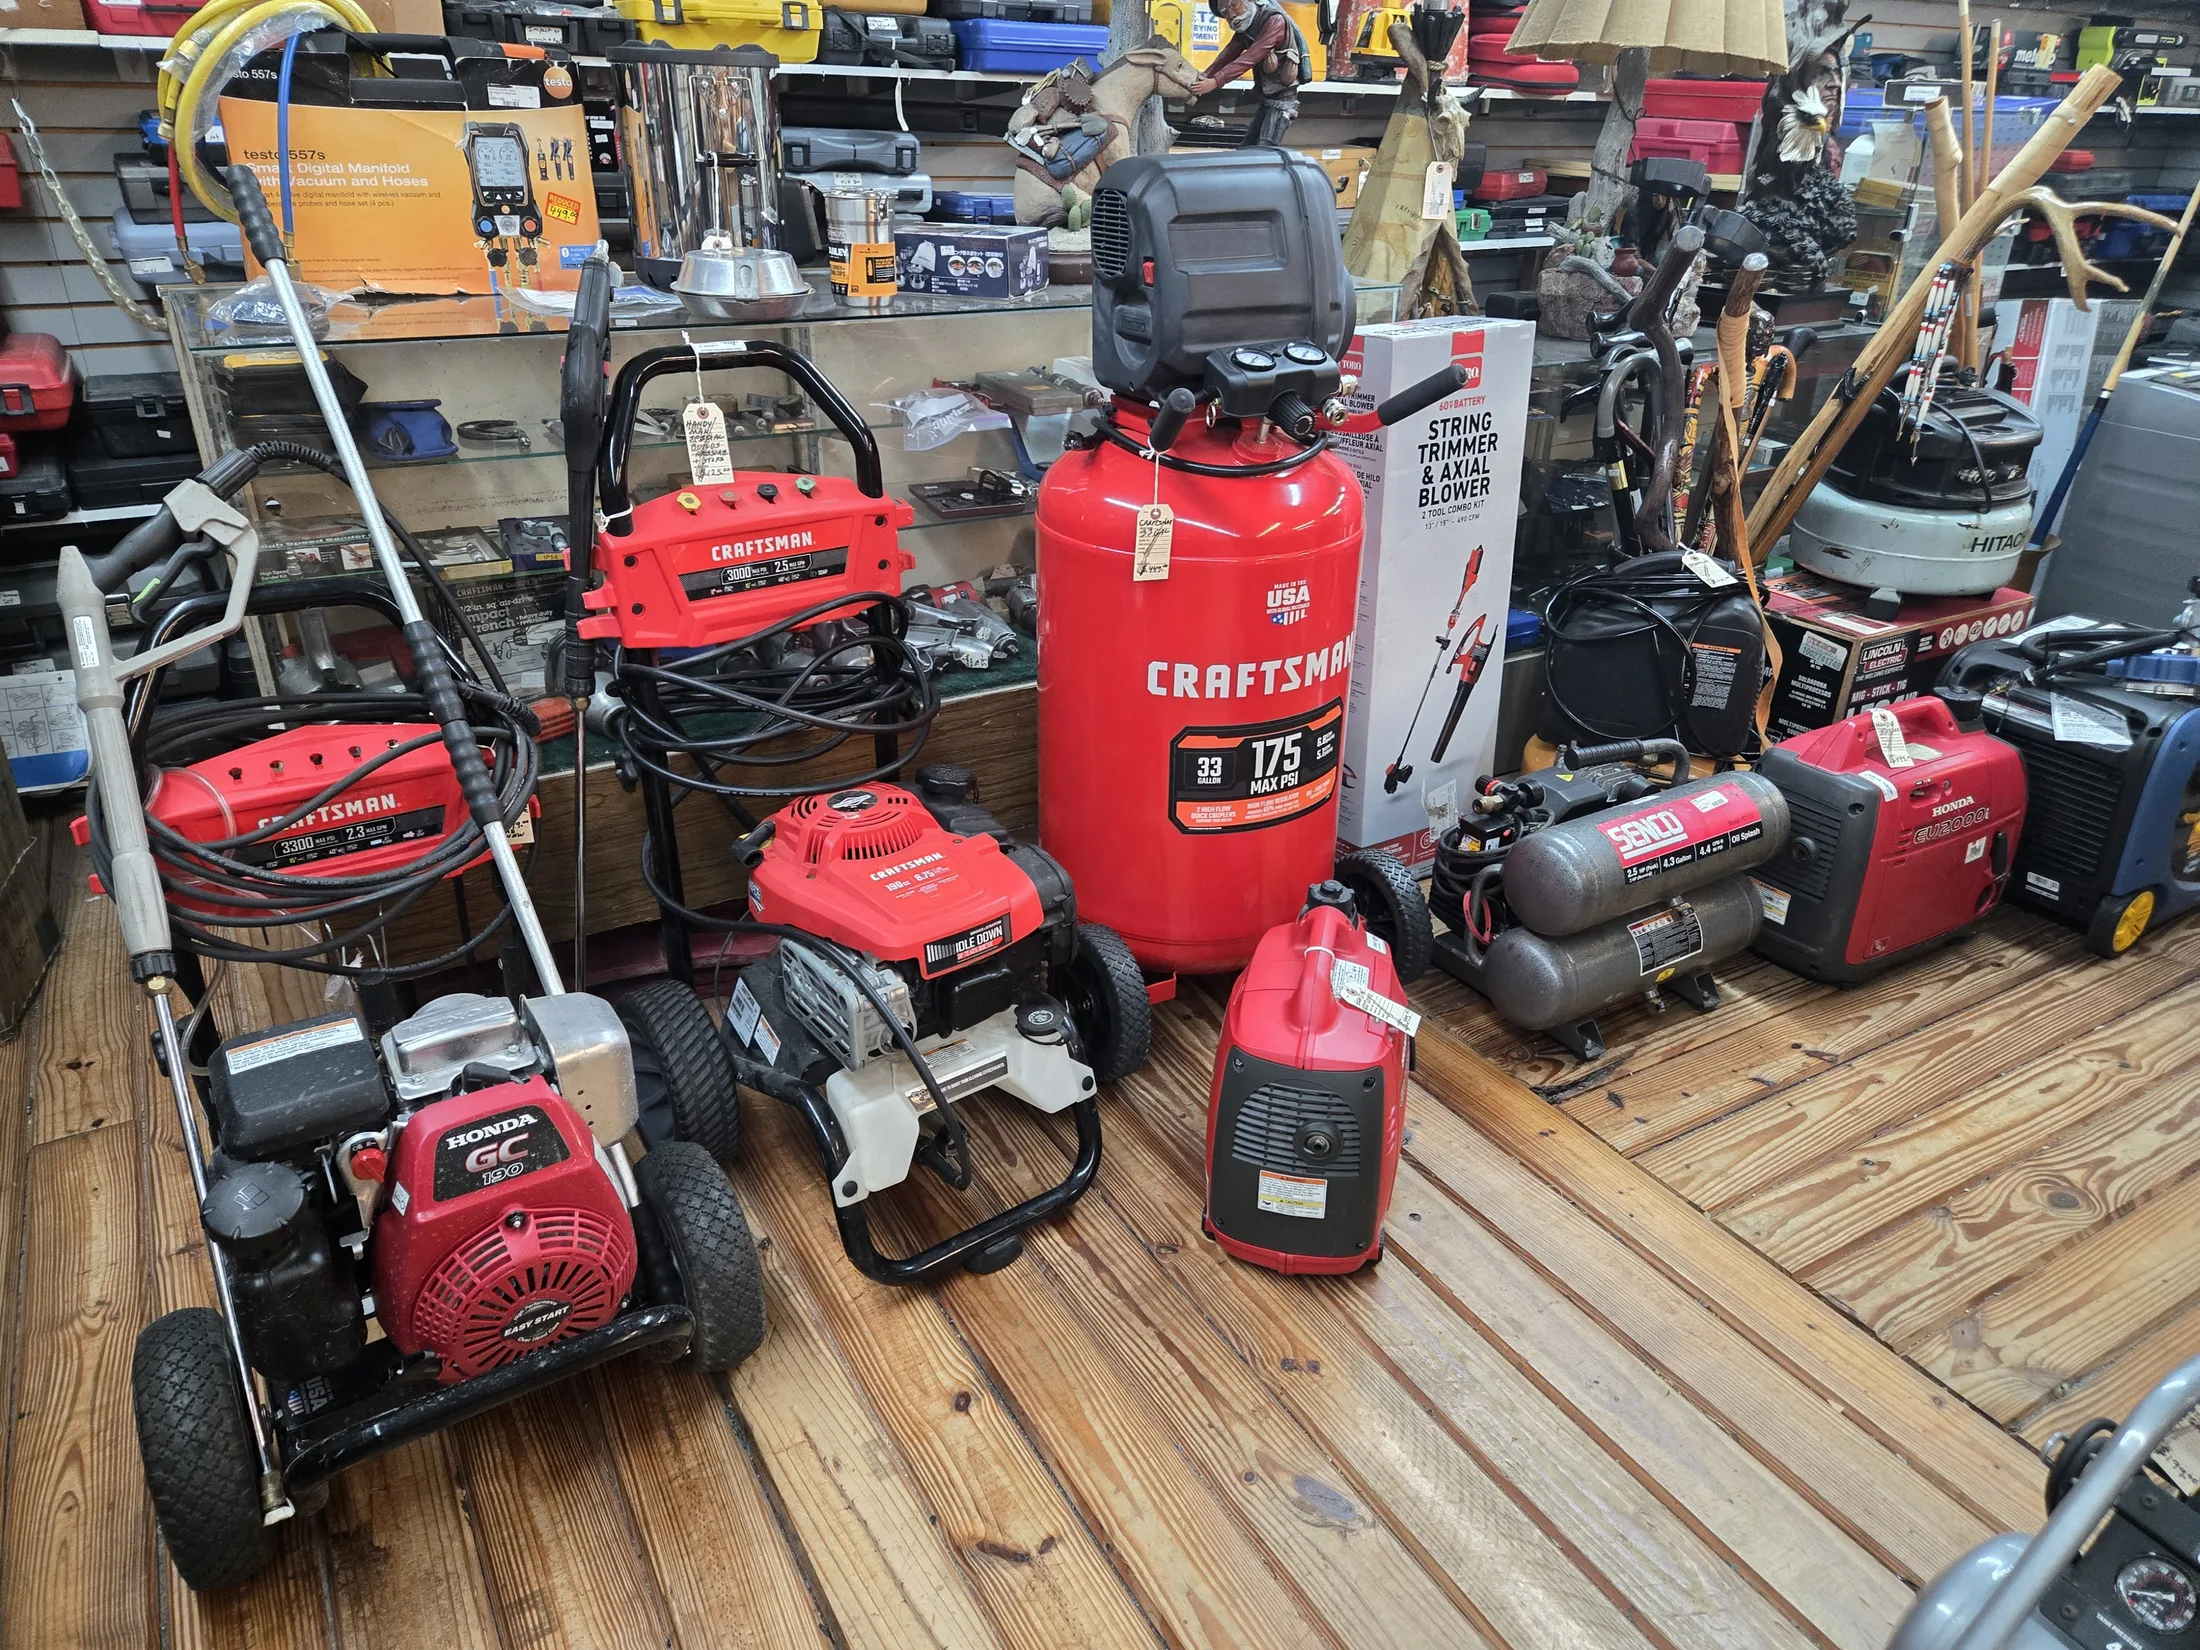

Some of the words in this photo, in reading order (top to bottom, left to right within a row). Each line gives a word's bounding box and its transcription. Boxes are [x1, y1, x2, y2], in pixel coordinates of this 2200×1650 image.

[231, 69, 250, 80] sto
[251, 69, 278, 80] 557s
[543, 76, 573, 88] testo
[289, 150, 326, 160] 557s
[247, 163, 292, 174] Smat
[297, 163, 344, 176] Digital
[349, 163, 410, 174] Manifold
[351, 176, 378, 187] and
[383, 176, 429, 187] Hoses
[299, 200, 323, 208] probes
[549, 194, 579, 209] REDUCED
[1349, 399, 1375, 411] BLOWER
[1454, 396, 1486, 409] BATTERY
[1428, 411, 1492, 440] STRING
[1364, 442, 1383, 453] AXIAL
[1418, 432, 1498, 464] TRIMMER
[1356, 471, 1365, 480] DE
[1366, 473, 1380, 483] HILO
[1422, 465, 1434, 486] &
[1439, 456, 1491, 483] AXIAL
[1418, 476, 1490, 508] BLOWER
[1422, 511, 1426, 519] 2
[1428, 507, 1446, 518] TOOL
[1447, 502, 1471, 515] COMBO
[1473, 499, 1485, 510] KIT
[711, 531, 813, 562] CRAFTSMAN
[726, 566, 751, 582] 3000
[774, 561, 789, 573] 2.5
[456, 583, 504, 597] CRAFTSMAN
[1266, 585, 1310, 608] USA
[467, 606, 510, 623] mpact
[472, 618, 516, 633] rench
[1863, 642, 1901, 661] LINCOLN
[1147, 630, 1355, 698] CRAFTSMAN
[1868, 654, 1903, 670] ELECTRIC
[1865, 671, 1884, 680] WELDING
[1884, 664, 1905, 674] EXPERTS
[1790, 680, 1832, 699] MULTIPROCESOS
[1798, 675, 1828, 690] SOLDADORA
[1851, 691, 1867, 702] MIG
[1871, 683, 1891, 698] STICK
[1896, 679, 1908, 691] TIG
[1251, 731, 1302, 779] 175
[1197, 757, 1223, 777] 33
[1250, 776, 1278, 795] MAX
[1281, 771, 1299, 789] PSI
[257, 793, 396, 831] CRFTSMAN
[1932, 795, 1975, 818] HONDA
[345, 825, 366, 841] 2.3
[1607, 810, 1684, 851] SENCO
[1731, 834, 1740, 844] Oil
[1740, 827, 1761, 842] Splash
[1914, 807, 1990, 845] EU2000i
[280, 837, 314, 855] 3300
[1700, 844, 1712, 856] 4.4
[869, 852, 944, 881] CRAFTSMAN
[1663, 856, 1676, 868] 4.3
[1675, 853, 1692, 864] Gallon
[914, 870, 936, 882] 8.75
[1627, 867, 1638, 878] 2.5
[955, 936, 976, 953] IDLE
[976, 925, 1003, 947] DOWN
[446, 1113, 538, 1150] HONDA
[465, 1132, 529, 1173] GC
[482, 1162, 524, 1186] 190
[524, 1300, 558, 1310] Performance
[503, 1319, 534, 1337] EASY
[534, 1305, 570, 1325] START
[532, 1331, 548, 1342] Head
[548, 1321, 560, 1334] Cam
[306, 1375, 328, 1412] USA
